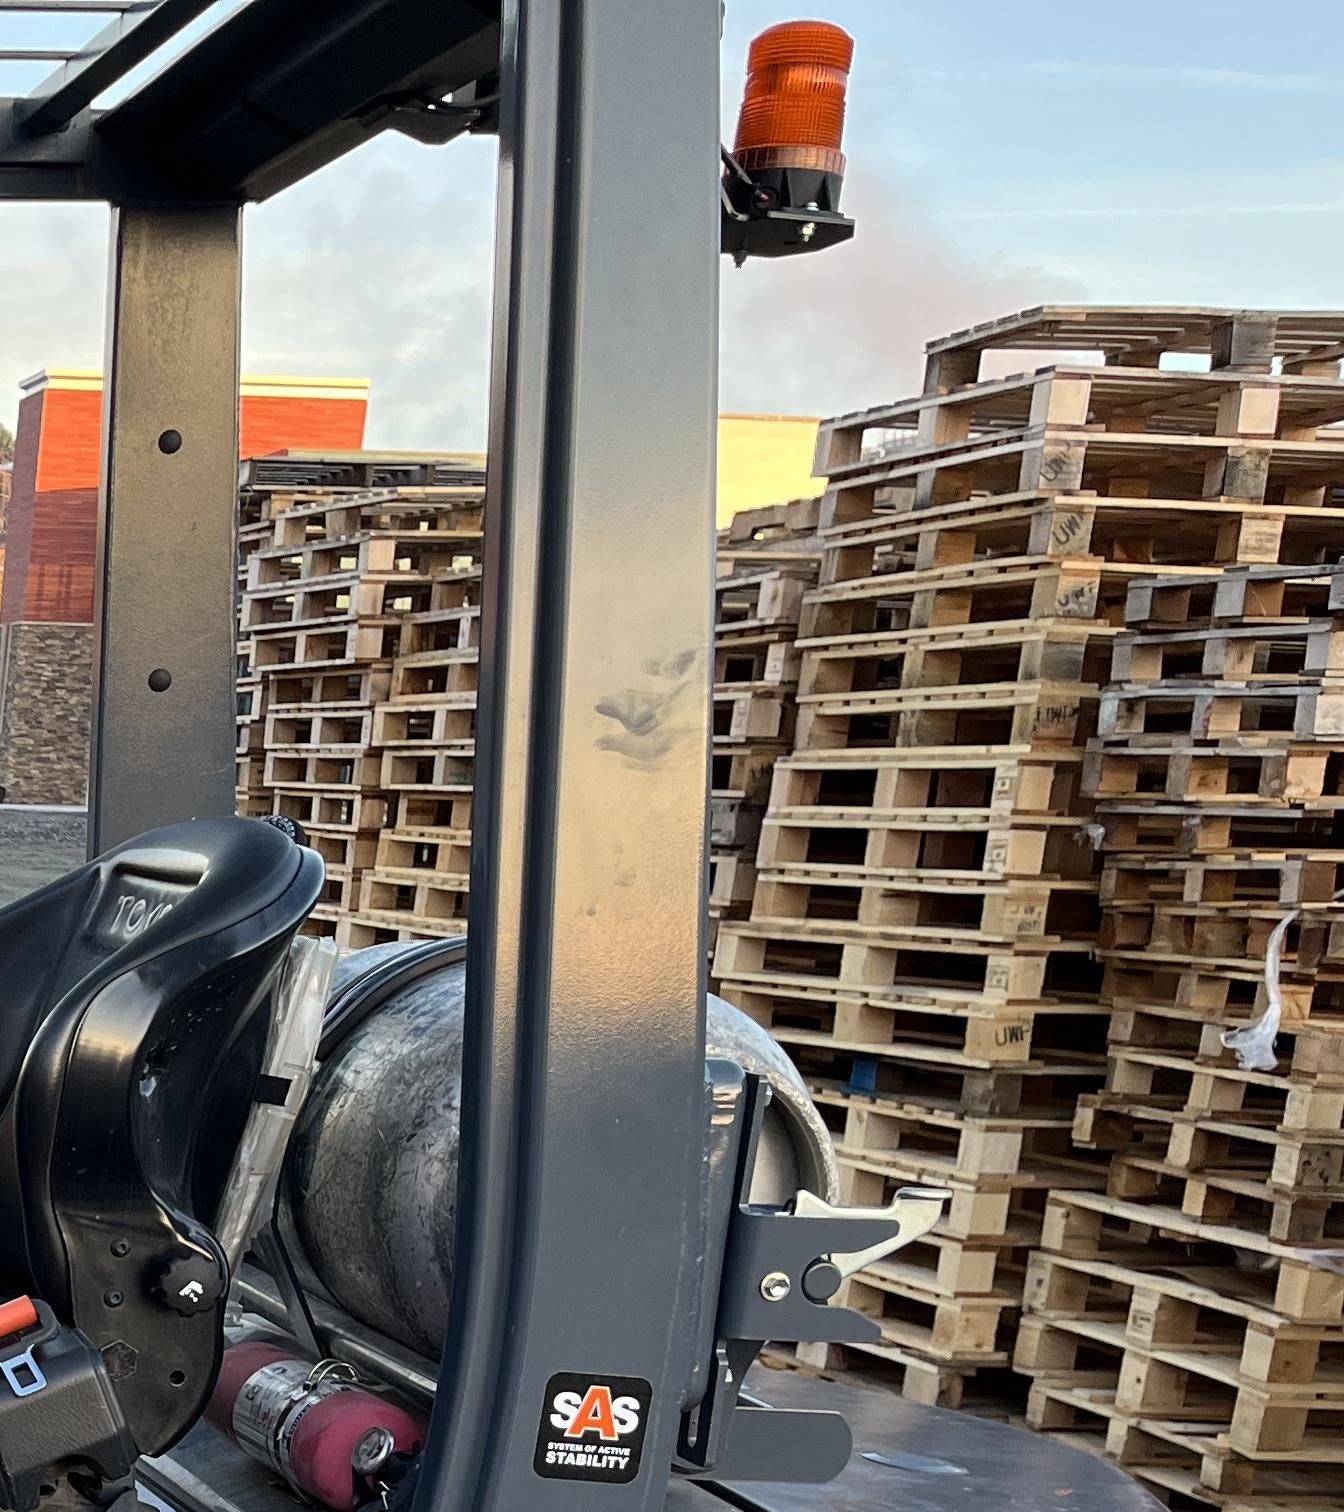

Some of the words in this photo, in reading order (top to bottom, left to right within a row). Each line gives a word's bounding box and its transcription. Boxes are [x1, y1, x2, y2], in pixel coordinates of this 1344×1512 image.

[549, 1384, 640, 1441] SAS
[547, 1441, 583, 1453] SYSTEM
[583, 1444, 597, 1454] OF
[597, 1446, 631, 1456] ACTIVE
[545, 1451, 630, 1470] STABILITY
